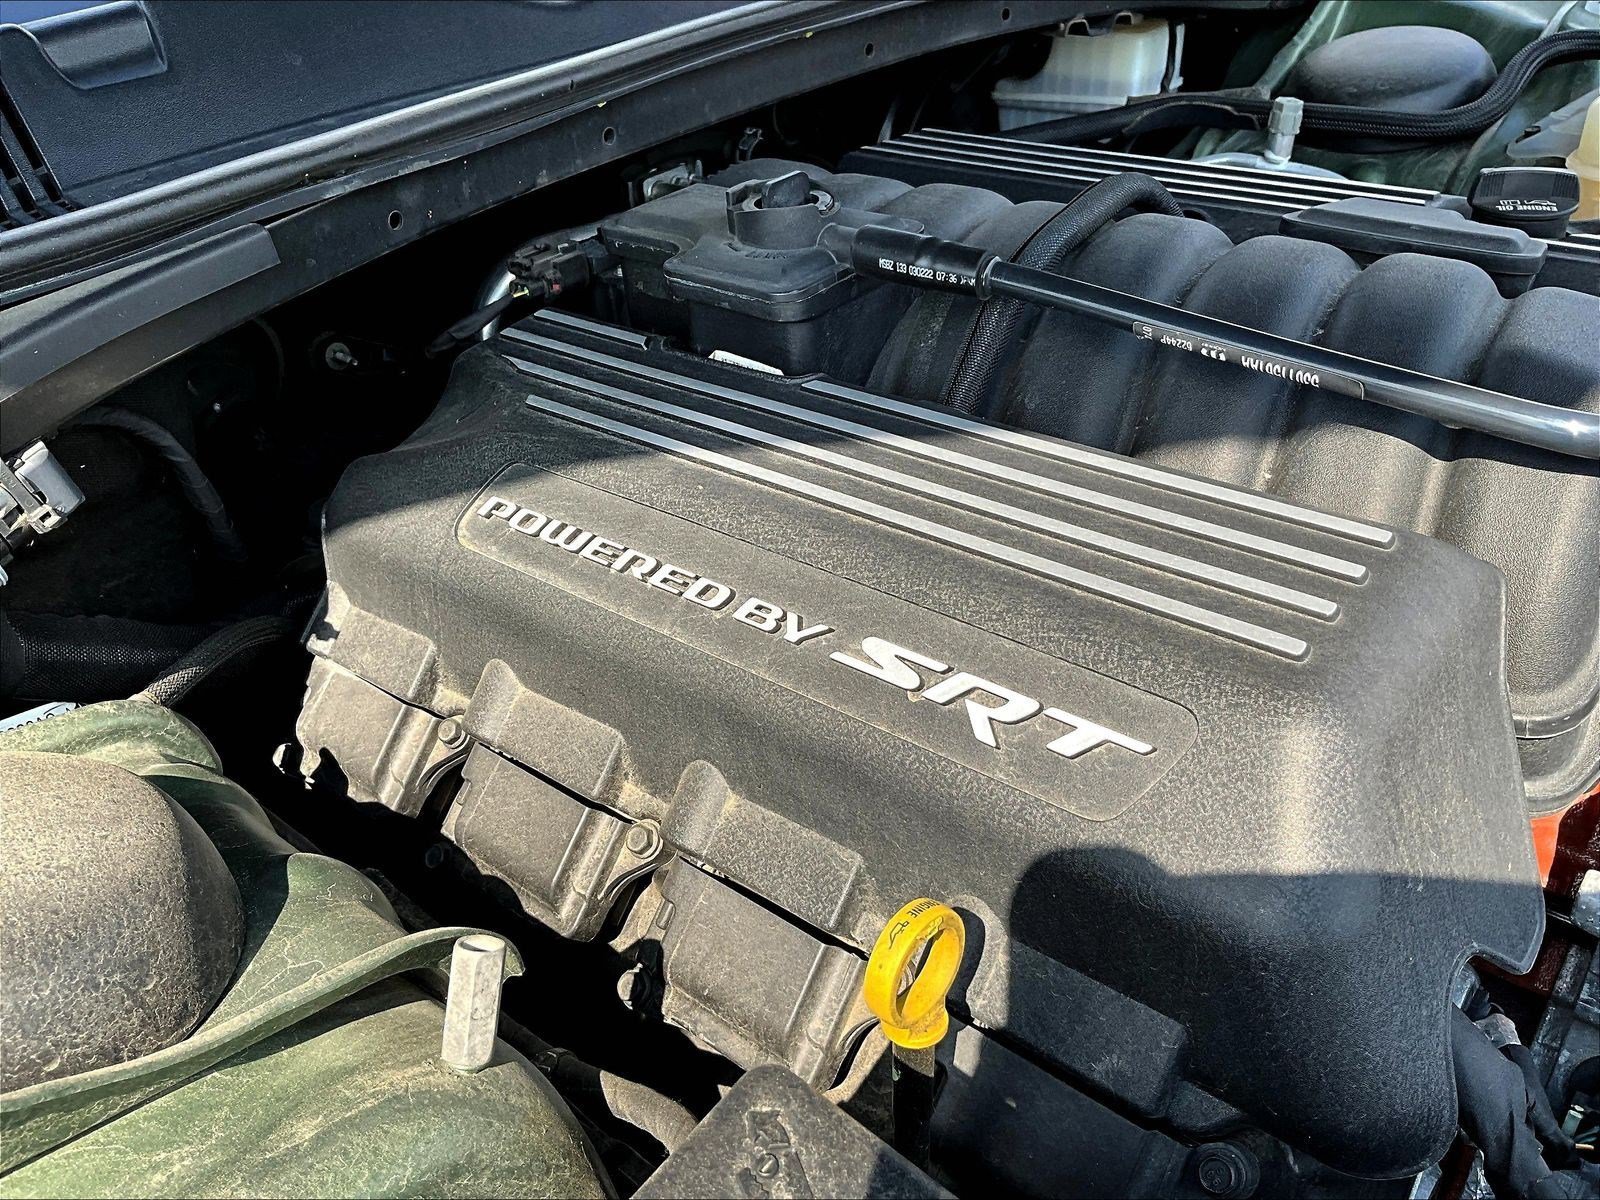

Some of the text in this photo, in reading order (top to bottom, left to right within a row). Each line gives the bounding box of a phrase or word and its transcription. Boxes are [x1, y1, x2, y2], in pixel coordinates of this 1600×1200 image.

[936, 271, 958, 284] 07:36
[477, 495, 1157, 759] POWERED BY SRT
[906, 900, 941, 919] ENGINE
